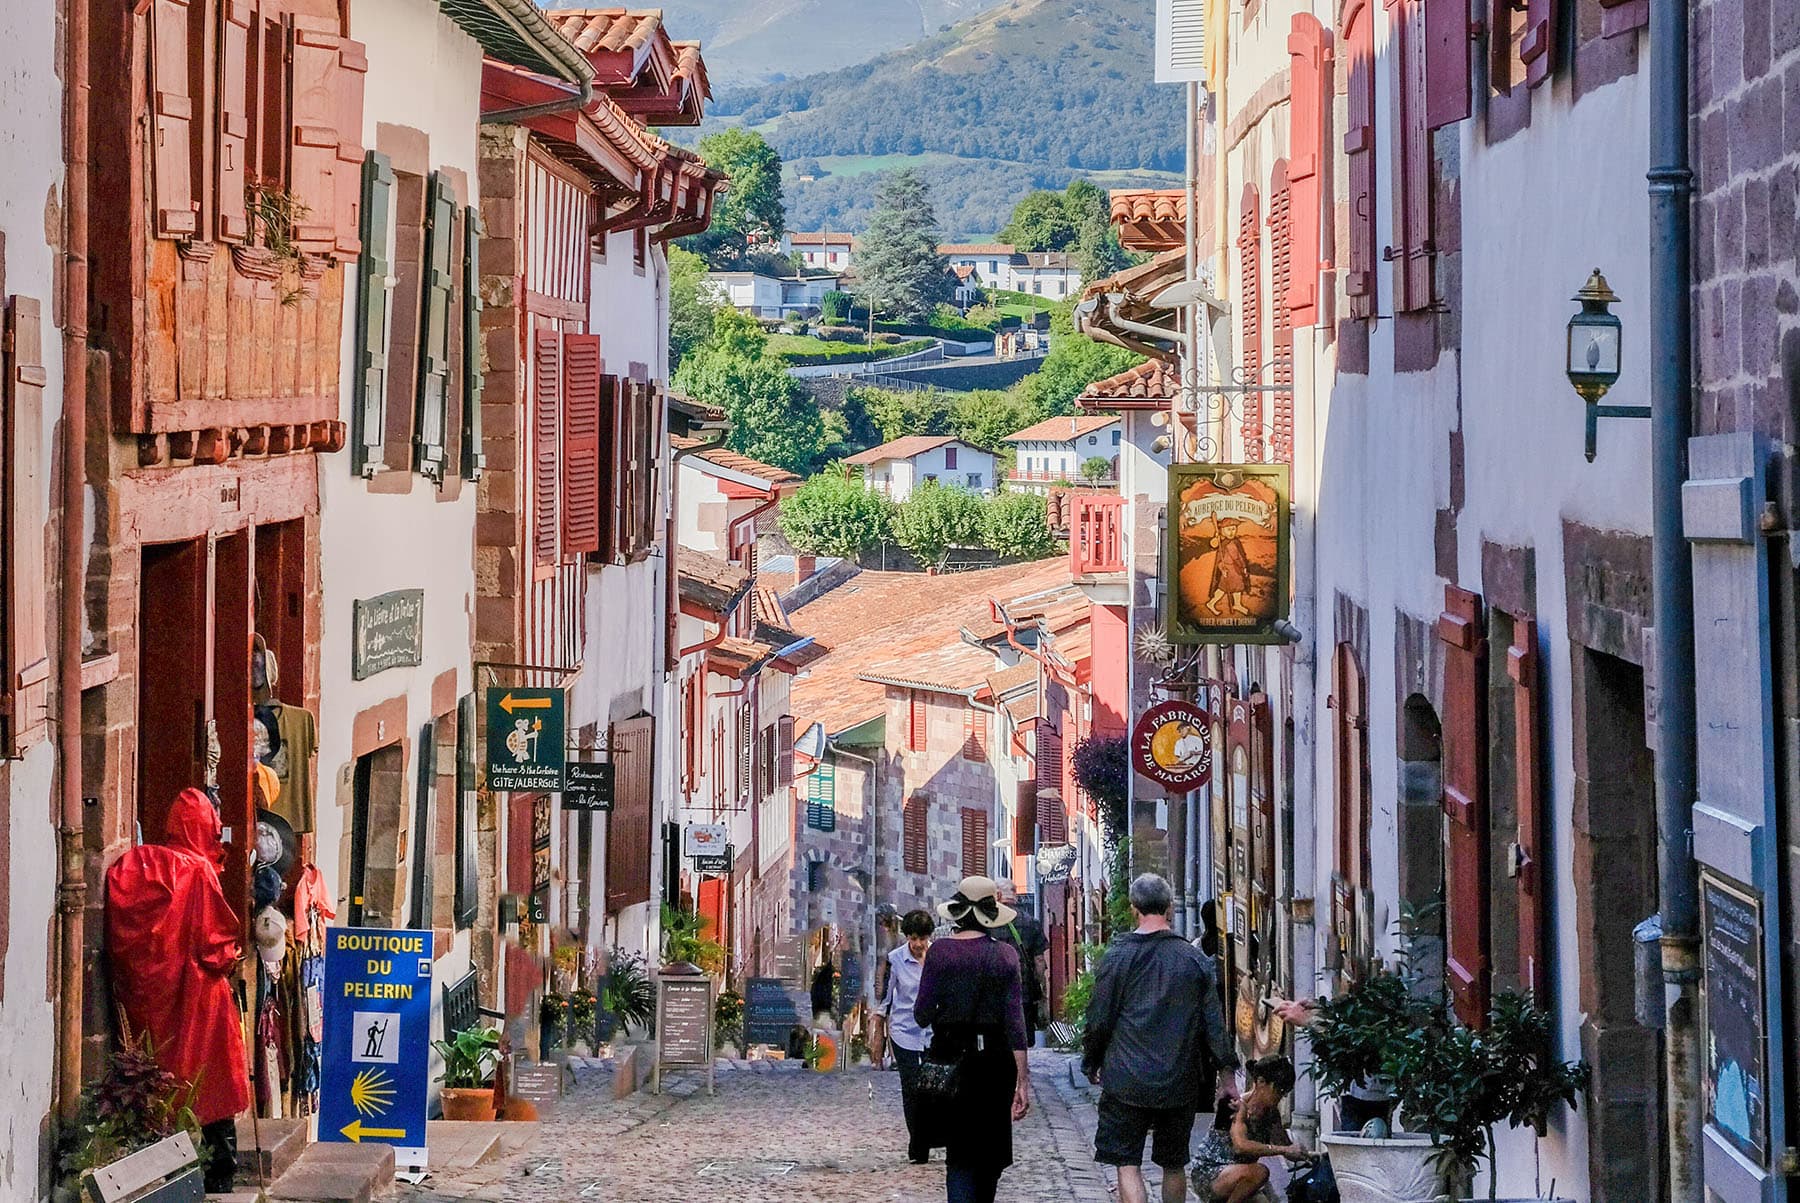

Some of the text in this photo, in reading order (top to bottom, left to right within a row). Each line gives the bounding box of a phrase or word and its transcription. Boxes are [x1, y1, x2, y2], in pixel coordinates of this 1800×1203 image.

[1194, 499, 1263, 516] AUBERGE DU PELERIN
[1141, 710, 1212, 750] LA FABRIQUE
[1143, 750, 1212, 782] DE MACARONS
[337, 934, 423, 954] BOUTIQUE
[367, 959, 392, 975] DU
[344, 982, 413, 999] PELERIN
